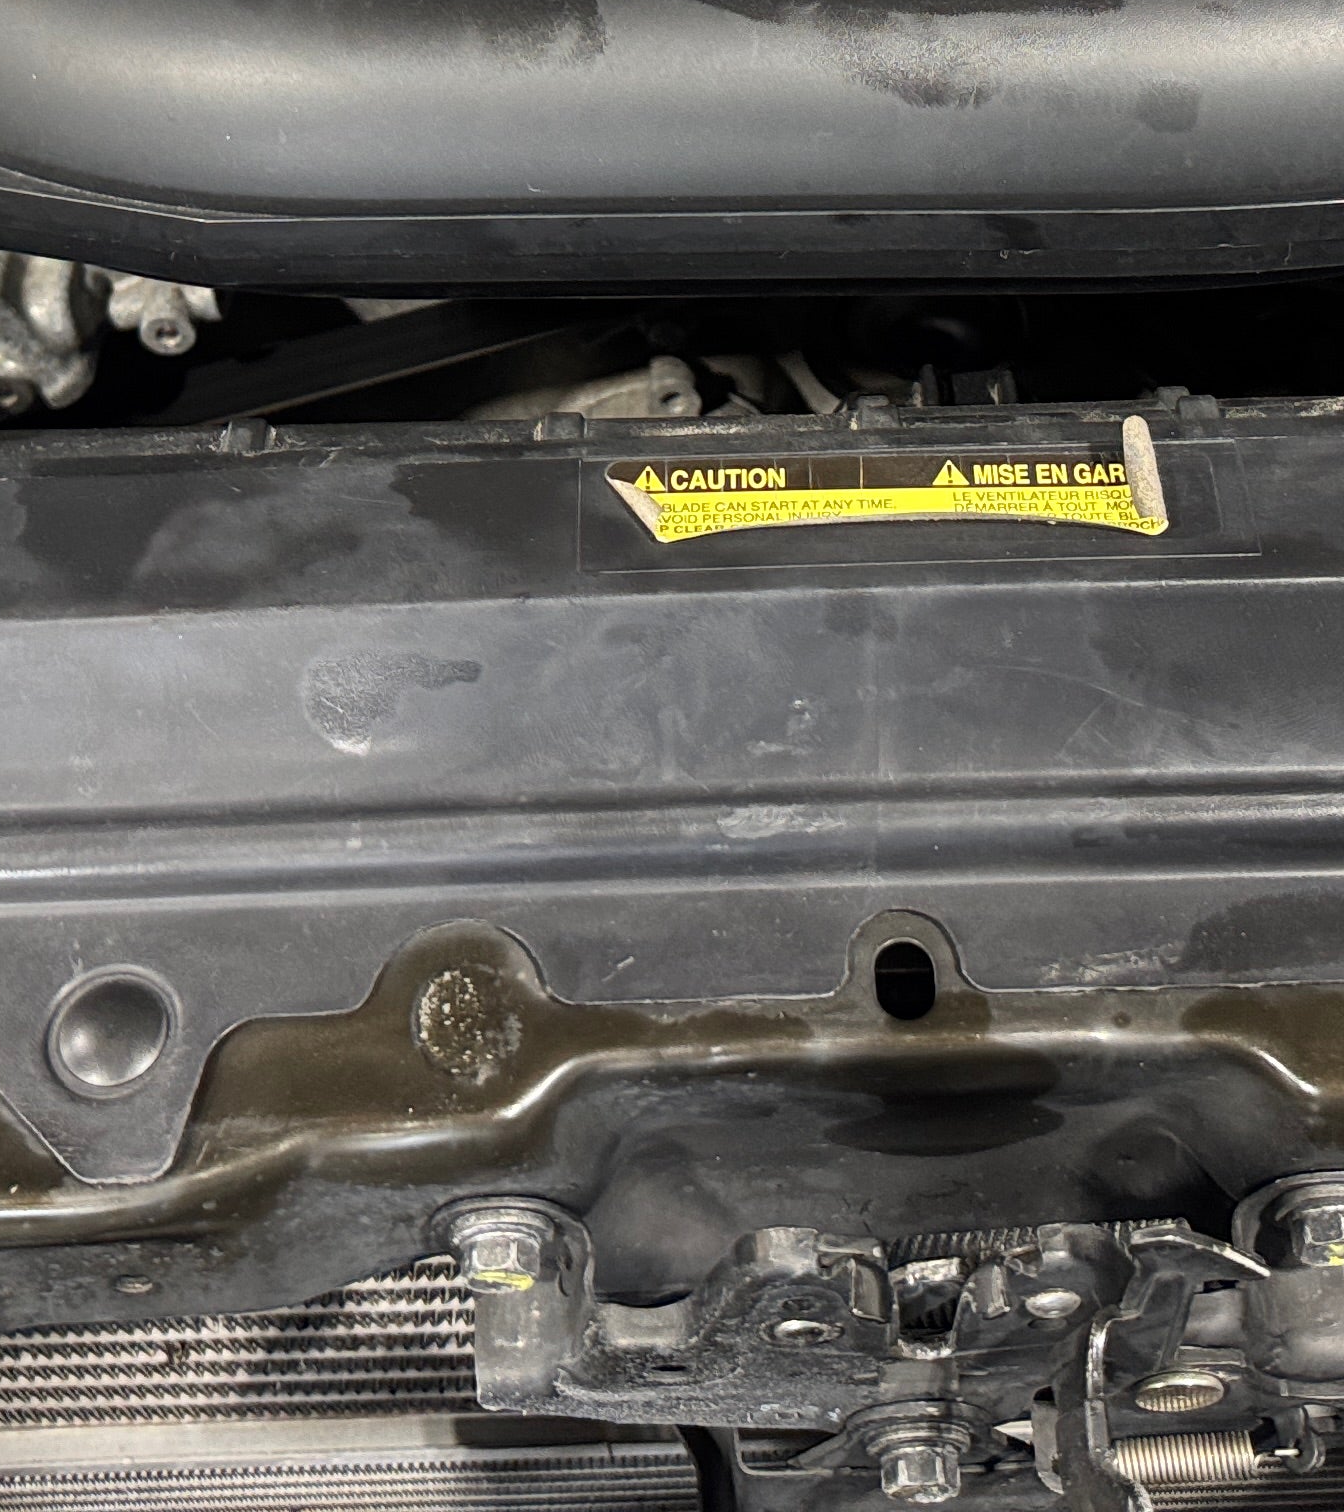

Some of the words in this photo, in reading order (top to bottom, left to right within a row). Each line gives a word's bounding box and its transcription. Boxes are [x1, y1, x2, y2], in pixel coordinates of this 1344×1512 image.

[670, 467, 787, 491] CAUTION
[973, 464, 1030, 485] MISE
[1035, 463, 1068, 484] EN
[1073, 463, 1125, 484] GAR
[953, 491, 971, 501] LE
[976, 490, 1080, 501] VENTILATEUR
[1085, 489, 1132, 500] RISQU
[661, 502, 711, 514] BLADE
[715, 501, 747, 513] CAN
[751, 500, 798, 512] START
[801, 500, 819, 511] AT
[823, 499, 853, 510] ANY
[1056, 501, 1096, 512] TOUT
[702, 512, 783, 524] PERSONAL
